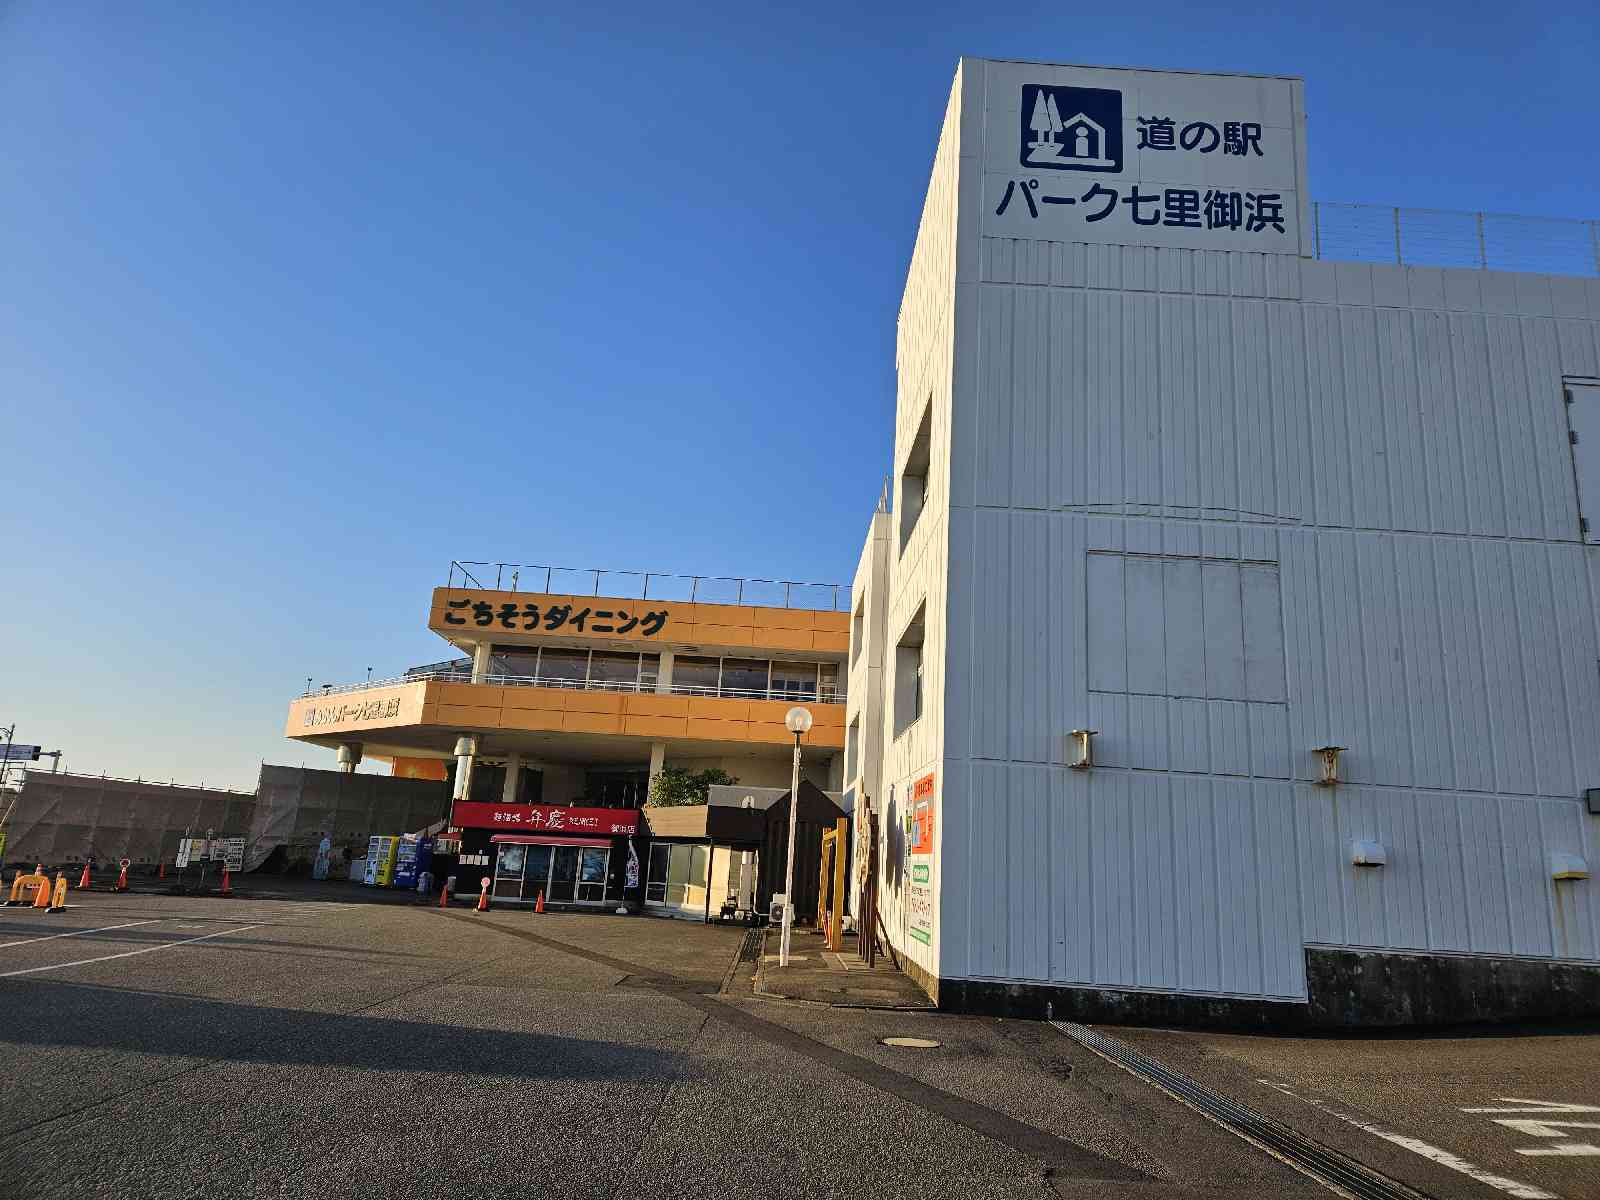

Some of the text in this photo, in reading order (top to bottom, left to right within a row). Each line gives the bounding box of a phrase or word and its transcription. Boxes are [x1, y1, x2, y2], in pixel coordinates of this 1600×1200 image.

[1137, 115, 1264, 157] 道の駅
[995, 178, 1285, 234] パーク七里御浜
[445, 599, 669, 636] ごちそうダイニング
